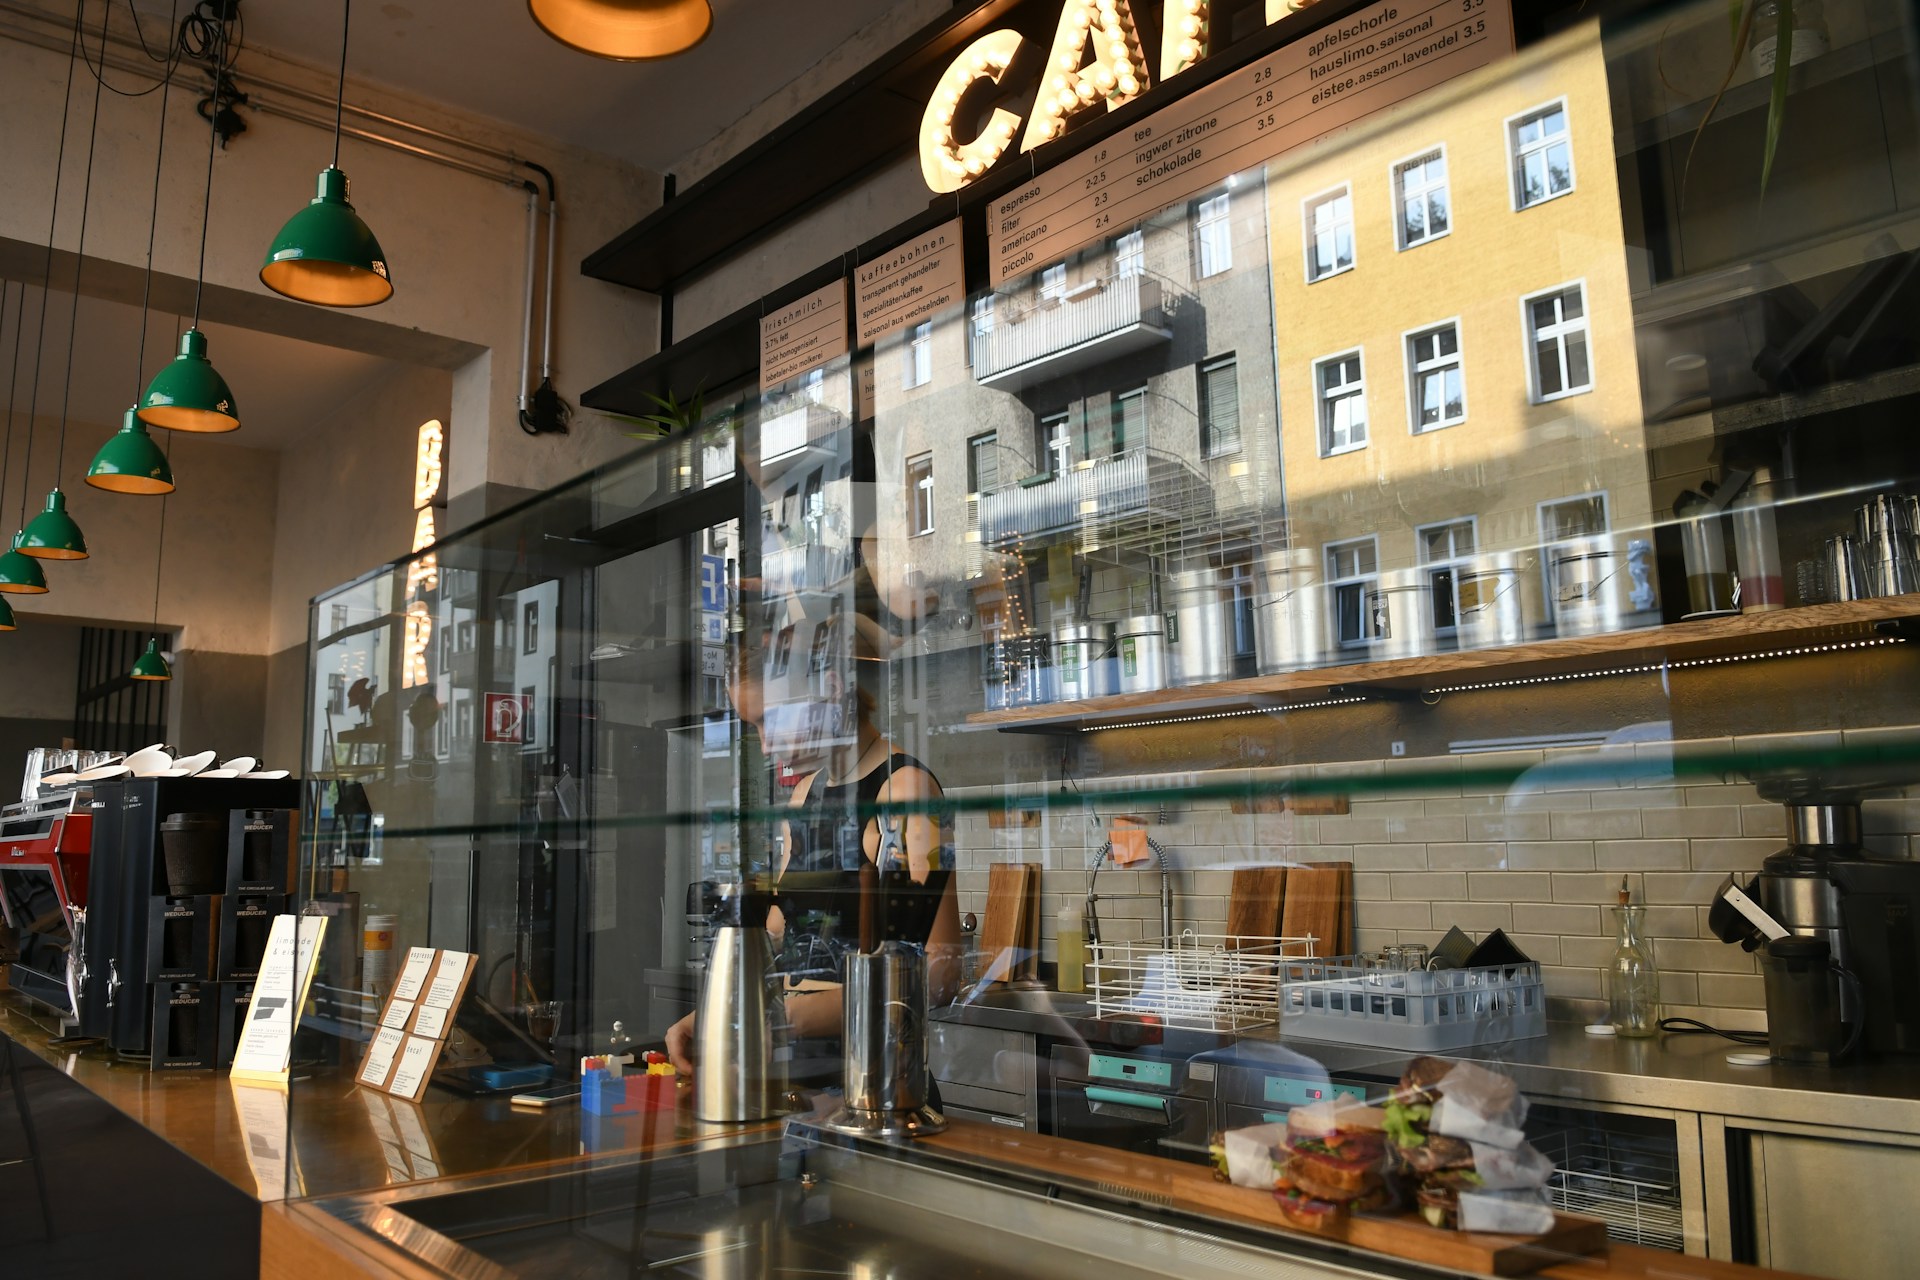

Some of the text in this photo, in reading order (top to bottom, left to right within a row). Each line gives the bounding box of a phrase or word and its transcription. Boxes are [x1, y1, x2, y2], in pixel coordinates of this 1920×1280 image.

[1308, 6, 1398, 58] apfelschorle
[1310, 16, 1434, 81] hauslimo.saisonal
[1312, 20, 1486, 104] eistee.assam.lavendel 3.5
[1134, 67, 1272, 142] tee 2.8
[1135, 91, 1274, 164] ingwer zitrone 2.8
[1136, 114, 1274, 186] schokolade 3.5
[1001, 150, 1106, 215] espresso 1.8
[1002, 172, 1106, 234] filter 2-2.5
[1002, 192, 1108, 254] americano 2.3
[1002, 214, 1110, 277] piccolo 2.4
[862, 236, 945, 284] kaffeebohnen
[862, 258, 940, 302] transparent gehandelter
[765, 298, 822, 332] frischmilch
[862, 284, 924, 318] spezialitätenkaffee
[864, 294, 950, 338] saisonal aus wechselnden
[764, 332, 789, 350] 3.7% fett
[765, 336, 818, 366] nicht homogenisiert
[799, 352, 823, 371] molkerei
[402, 419, 444, 690] BAR
